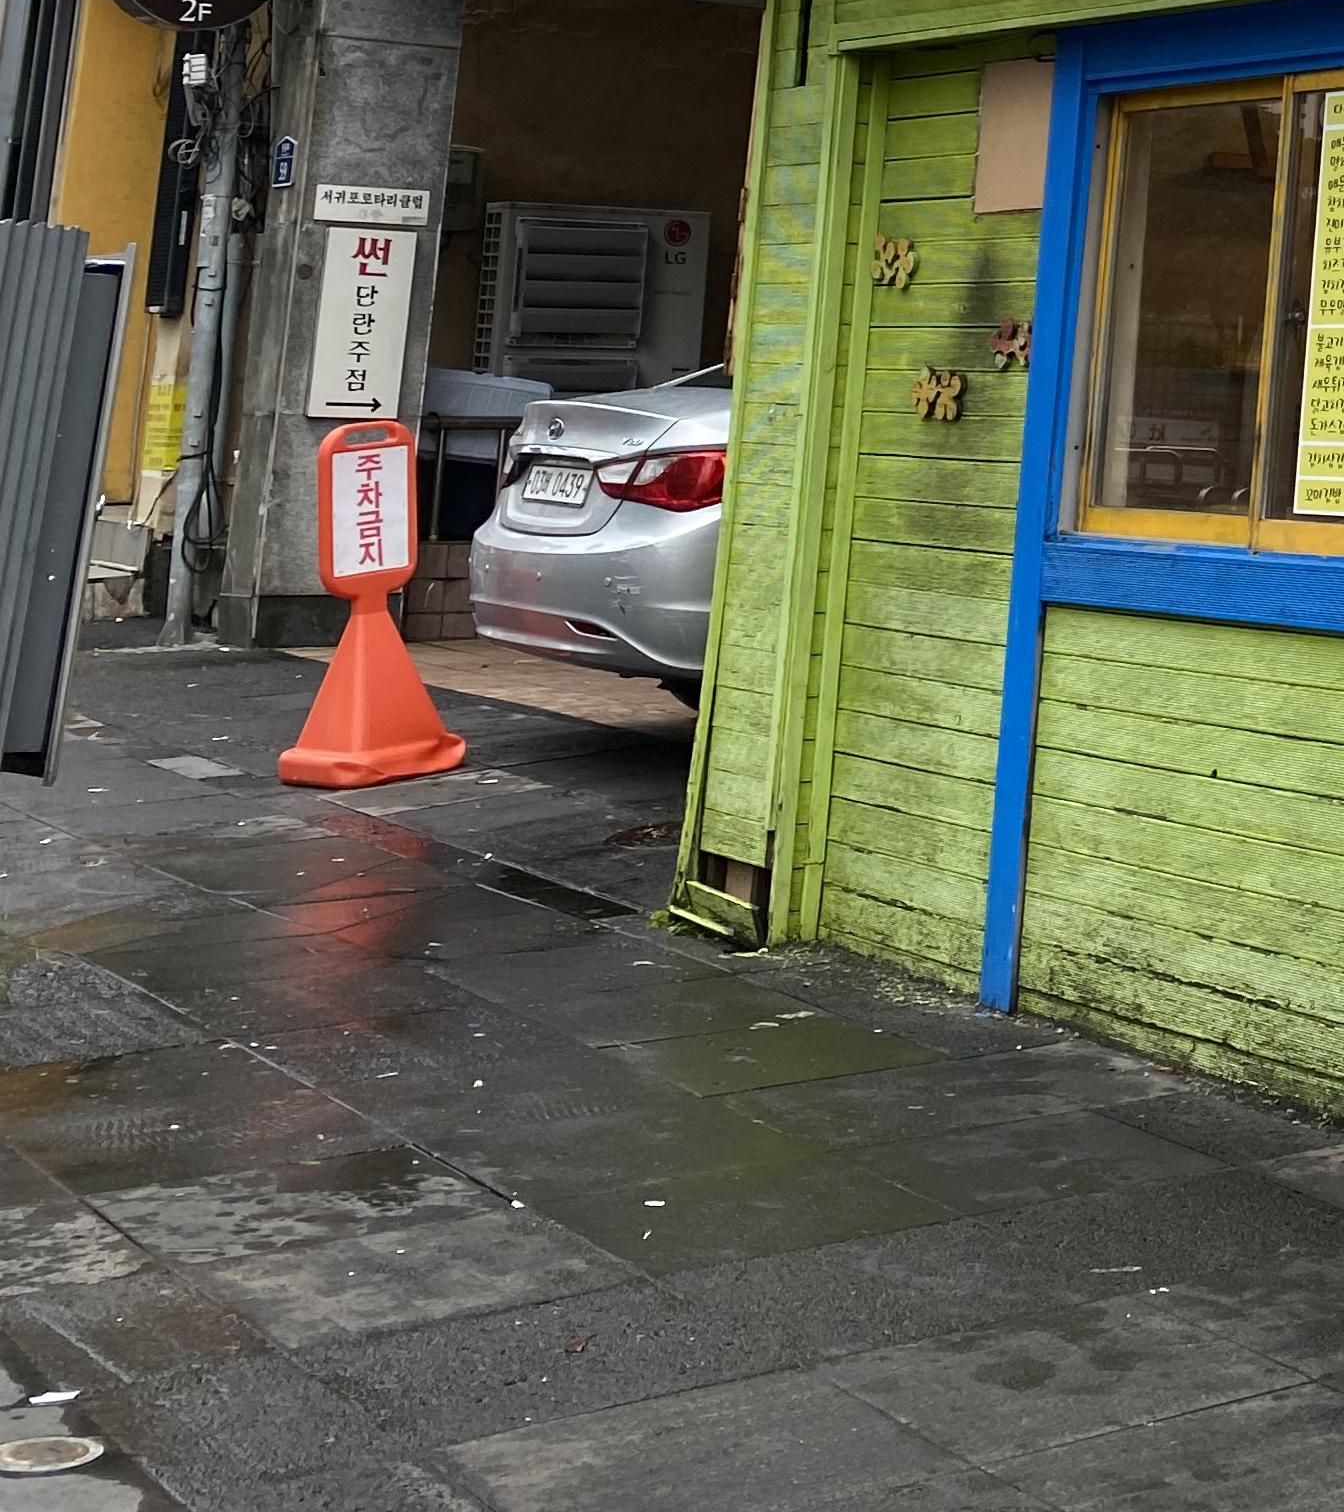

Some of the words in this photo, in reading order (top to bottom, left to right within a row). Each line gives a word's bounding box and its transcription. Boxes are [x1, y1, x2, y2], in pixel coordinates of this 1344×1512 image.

[351, 236, 393, 277] 썬
[664, 251, 687, 265] LG
[345, 285, 379, 392] 단란주점
[354, 453, 384, 567] 주차금지
